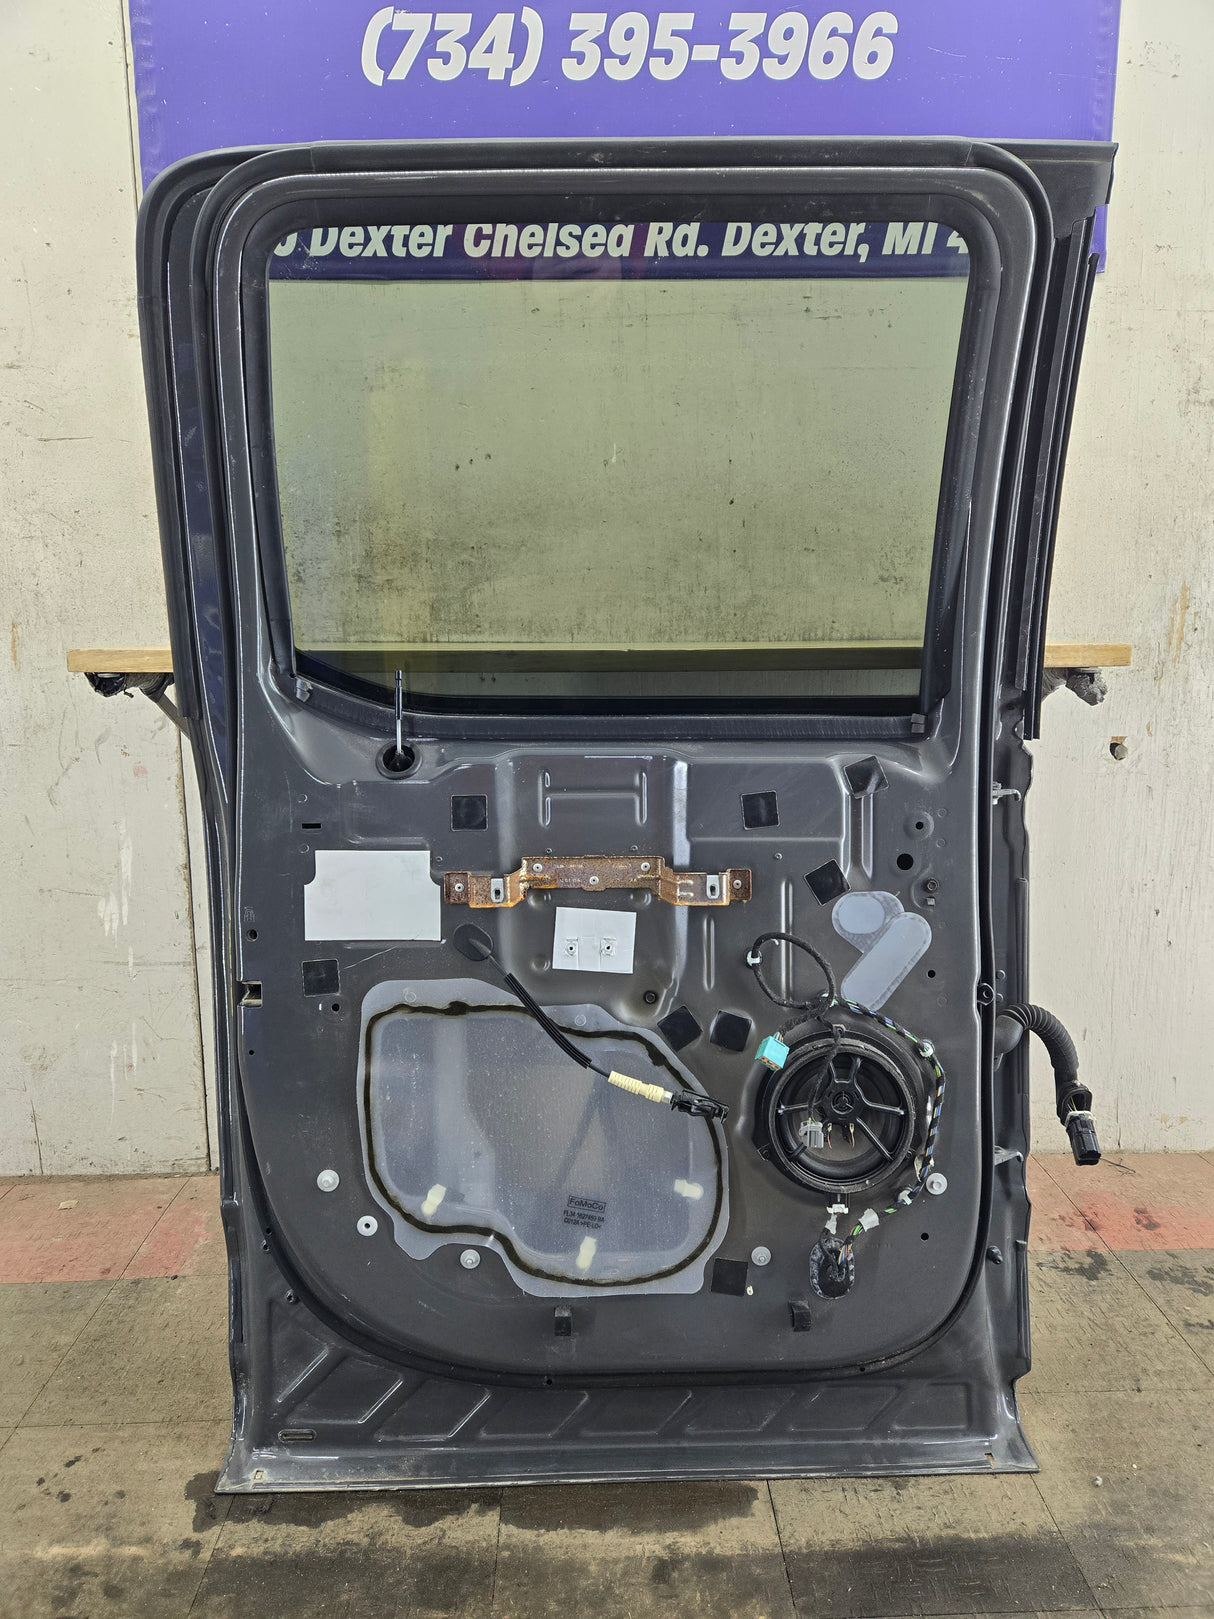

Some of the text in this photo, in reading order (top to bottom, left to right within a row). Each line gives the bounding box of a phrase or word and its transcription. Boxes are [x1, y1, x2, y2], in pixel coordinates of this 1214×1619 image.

[361, 6, 898, 87] (734) 395-3966
[308, 224, 453, 257] Dexter
[463, 223, 635, 258] Chelsea
[643, 222, 709, 257] Rd.
[721, 222, 870, 262] Dexter,
[881, 221, 939, 255] MI
[569, 1198, 604, 1211] FoMoCo
